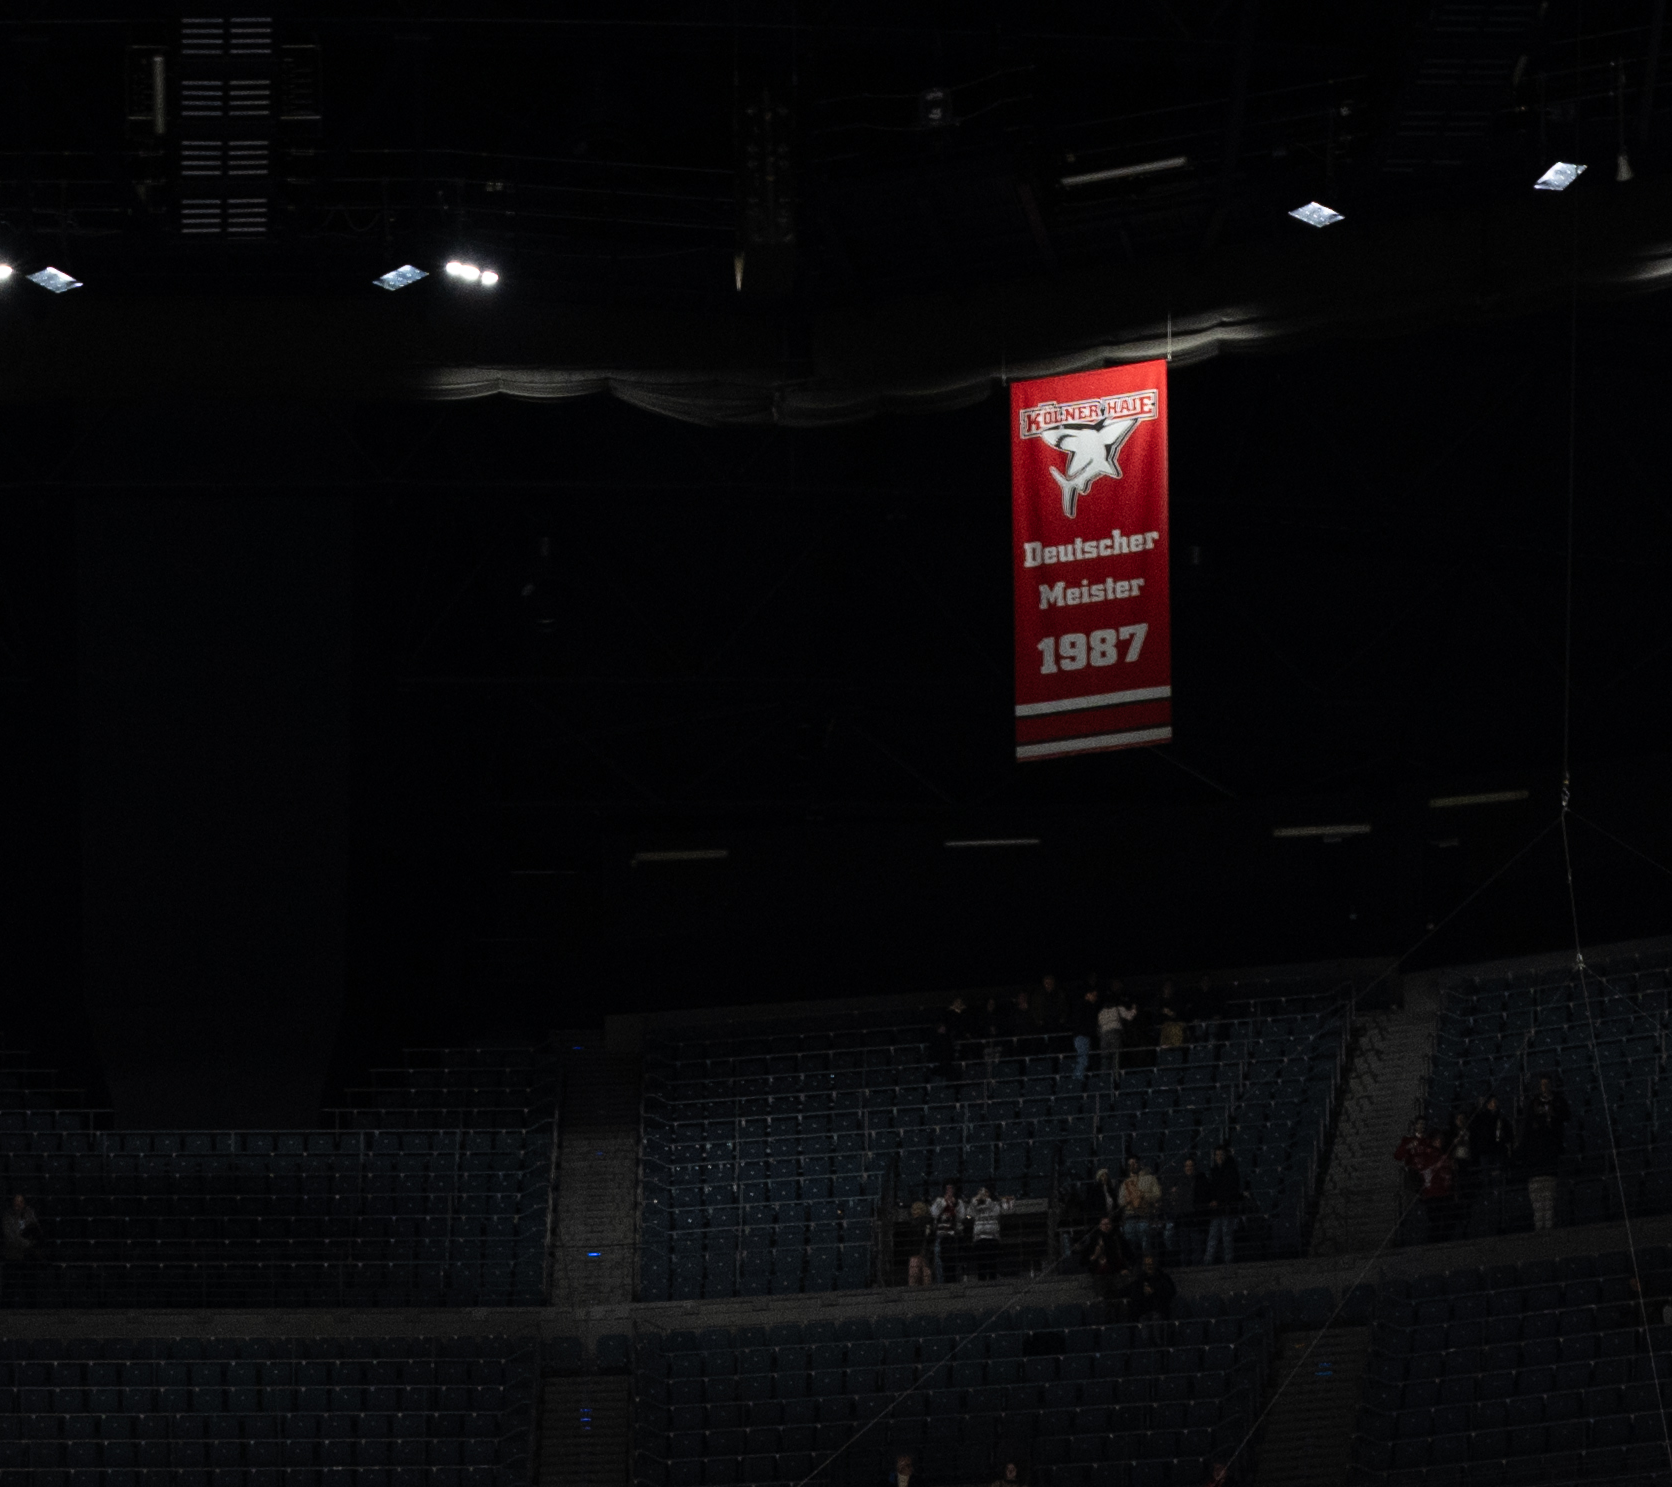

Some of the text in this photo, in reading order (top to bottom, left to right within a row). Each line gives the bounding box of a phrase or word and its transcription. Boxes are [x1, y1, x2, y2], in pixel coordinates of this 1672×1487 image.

[1026, 394, 1153, 433] KÖLNER HAIE
[1023, 529, 1159, 568] Deutscher
[1039, 577, 1144, 610] Meister
[1037, 623, 1148, 674] 1987
